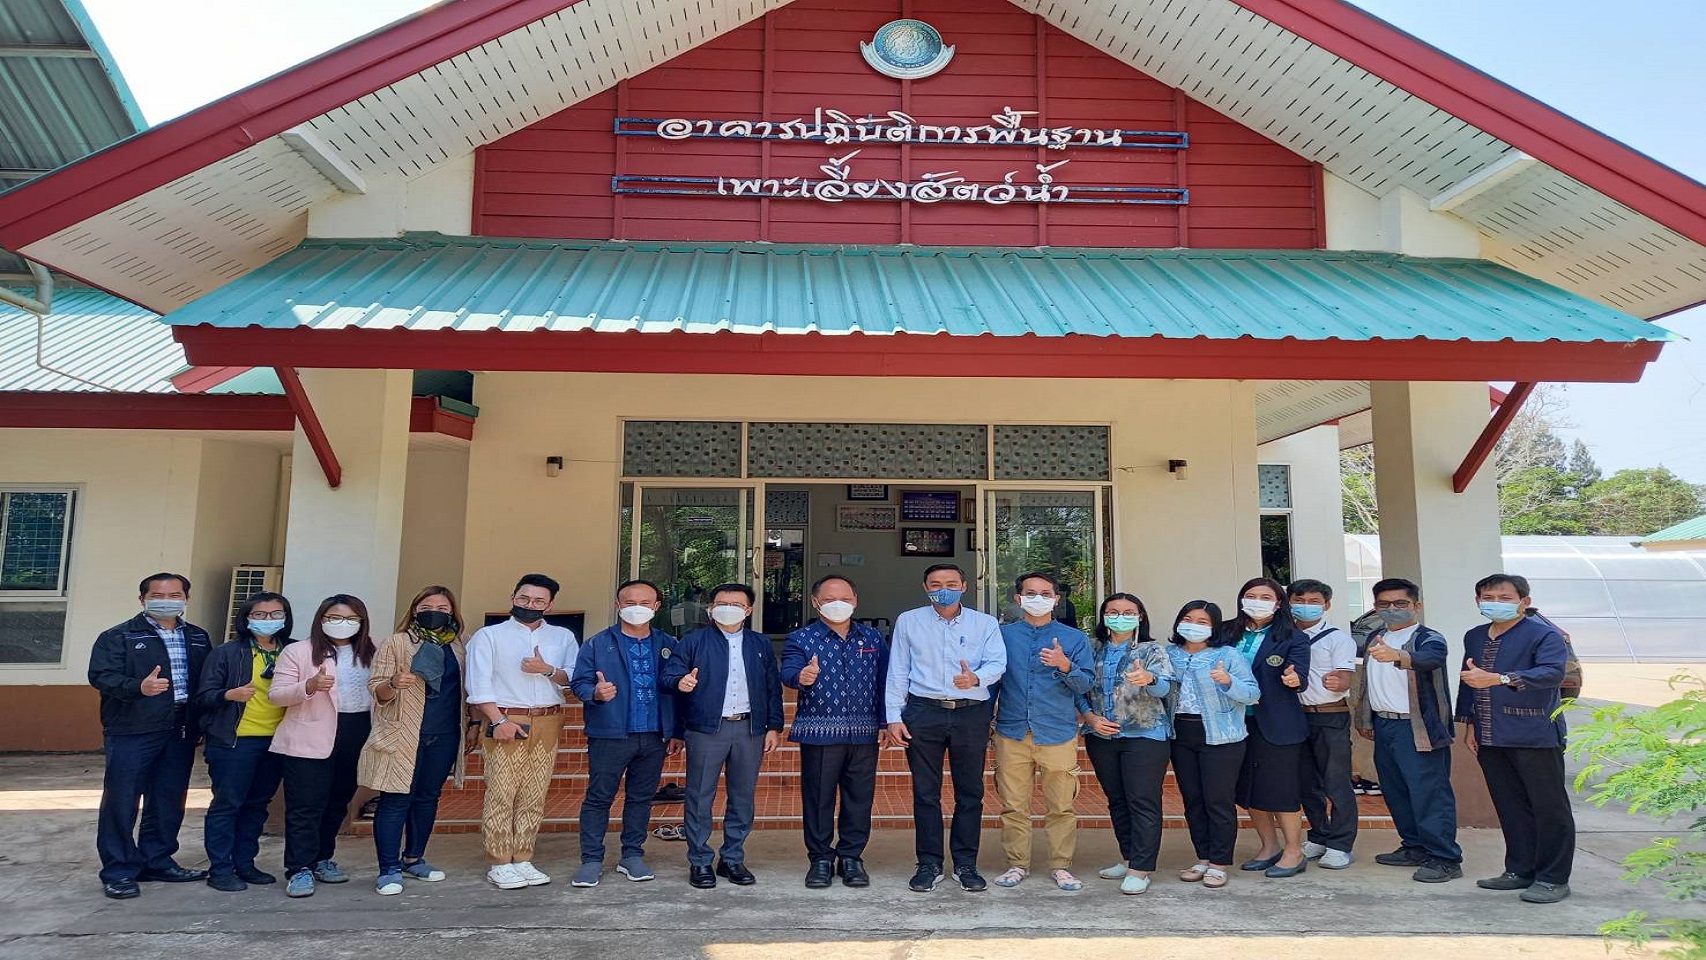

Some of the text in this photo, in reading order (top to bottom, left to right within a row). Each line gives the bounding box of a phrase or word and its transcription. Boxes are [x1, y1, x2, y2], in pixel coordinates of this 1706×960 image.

[657, 107, 1122, 150] อาคารปฏิบัติการพื้นฐาน
[718, 150, 1070, 205] เพาะเลี้ยงสัตว์น้ำ
